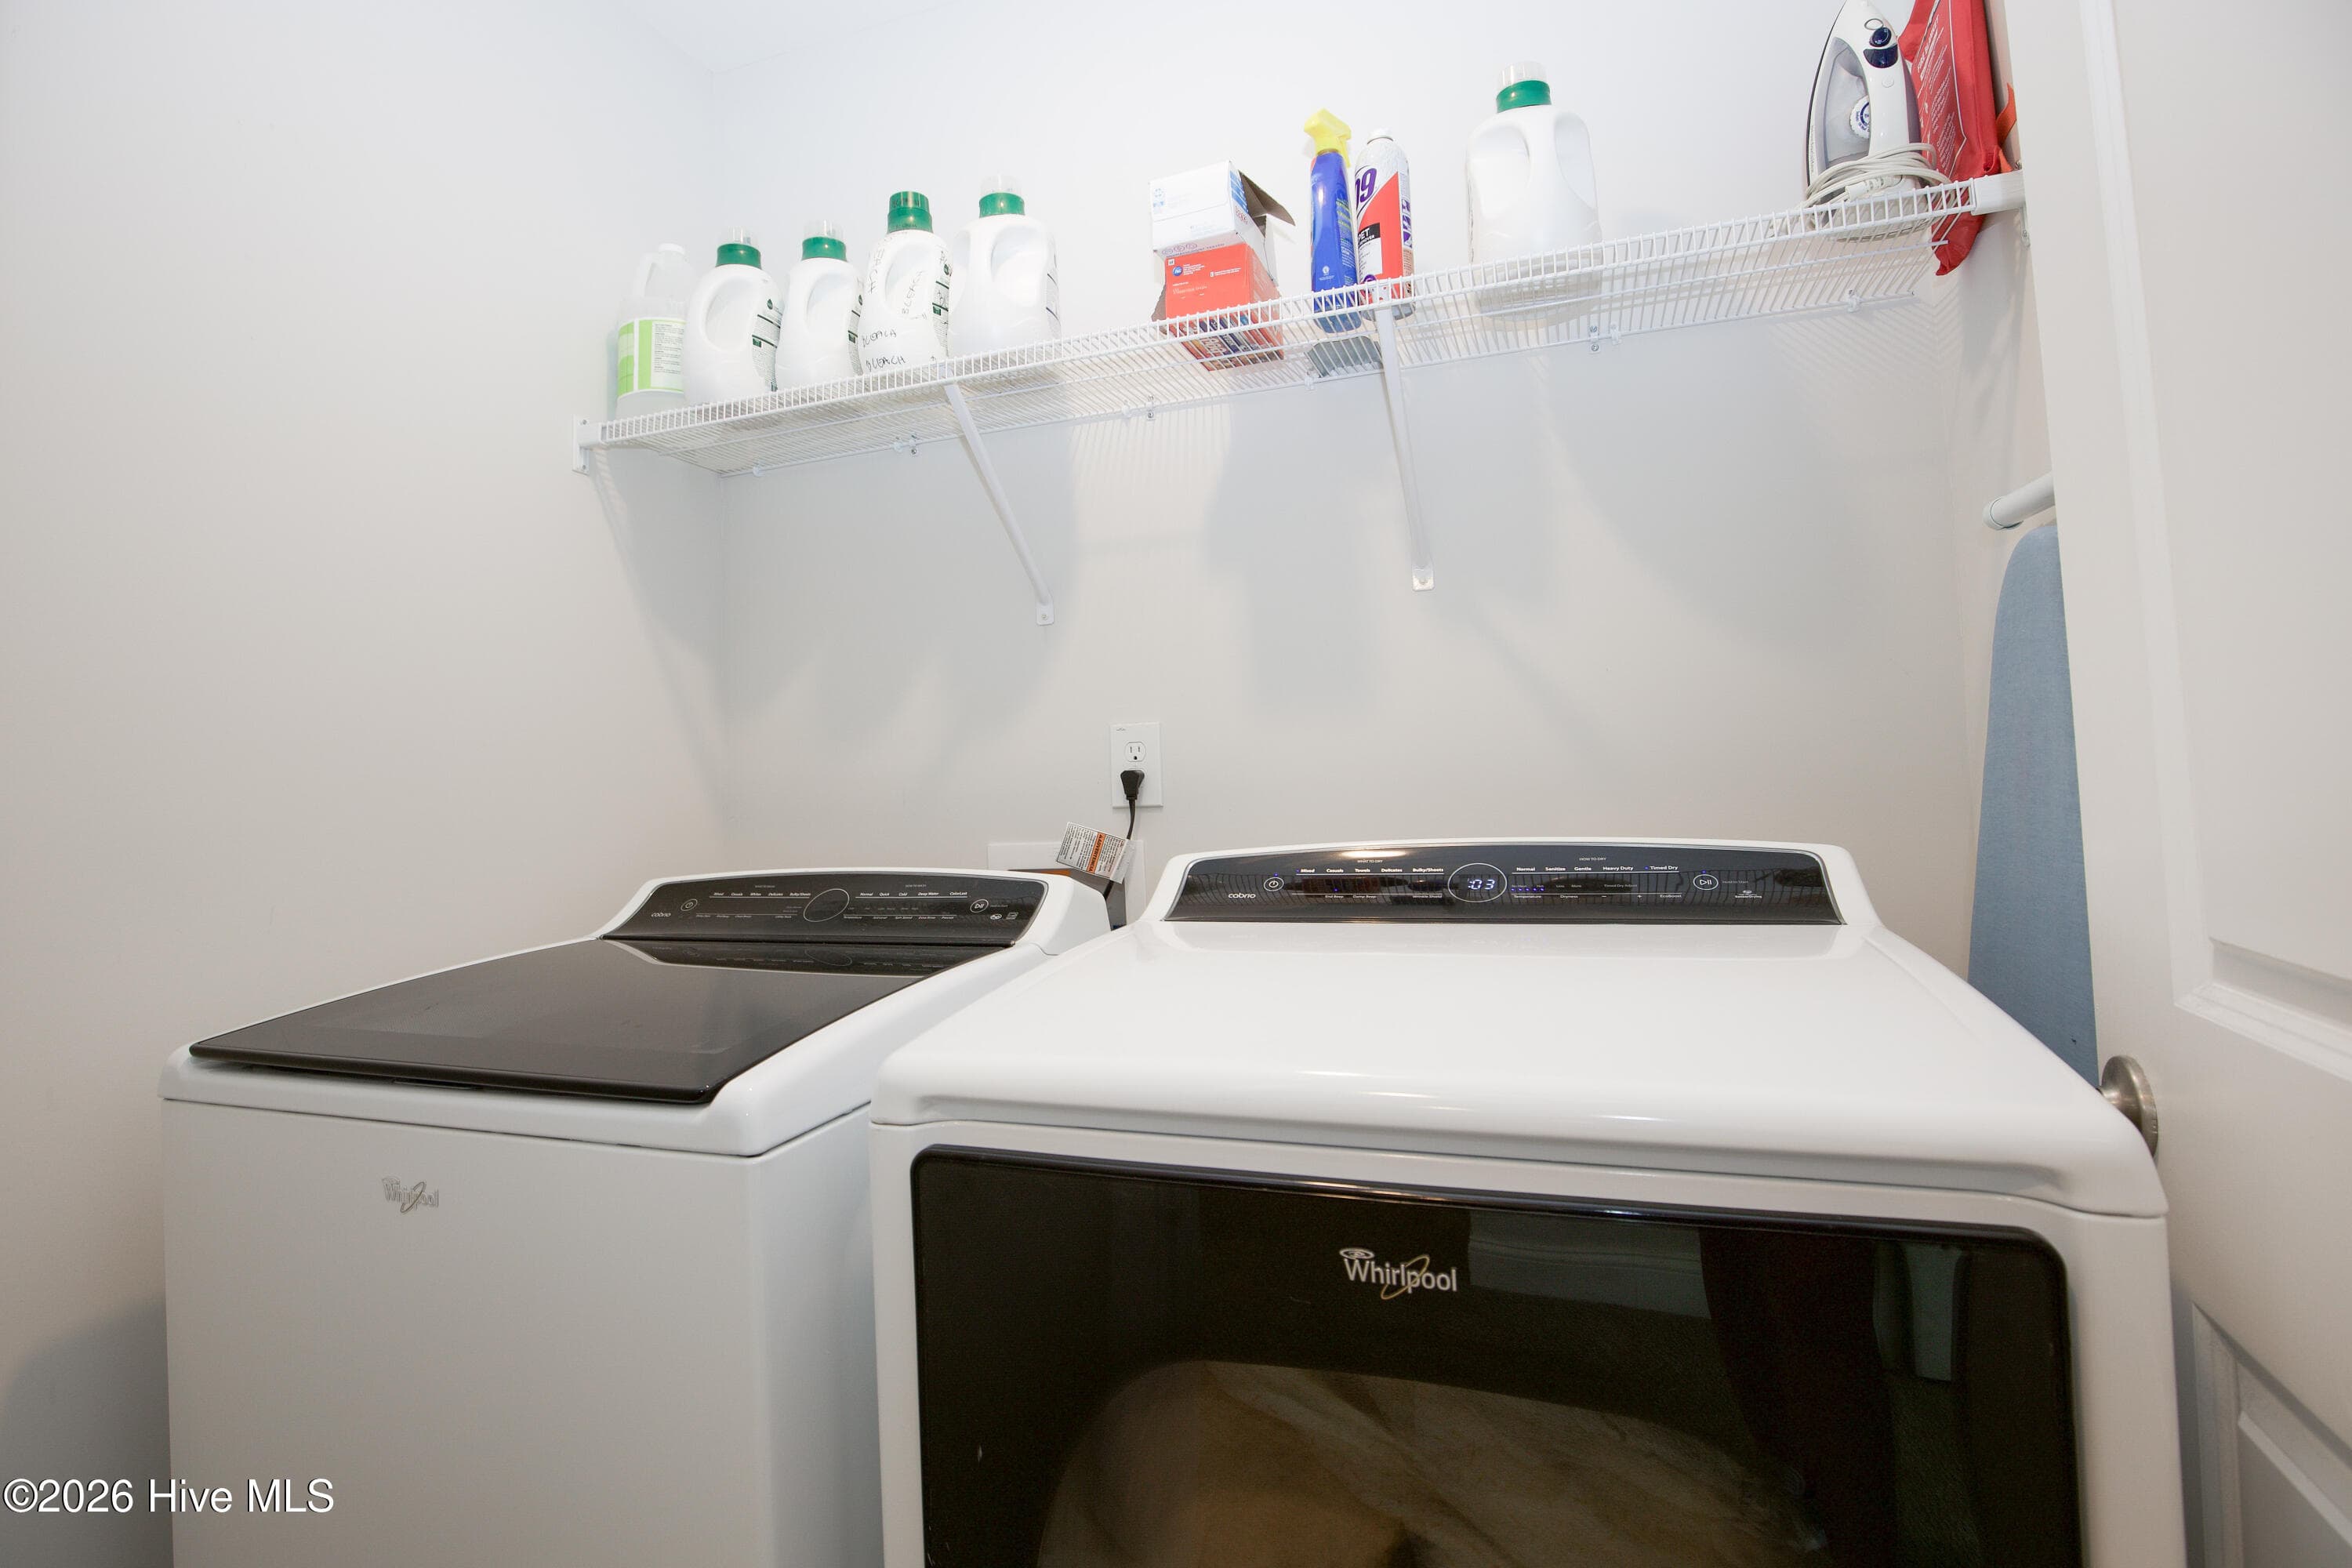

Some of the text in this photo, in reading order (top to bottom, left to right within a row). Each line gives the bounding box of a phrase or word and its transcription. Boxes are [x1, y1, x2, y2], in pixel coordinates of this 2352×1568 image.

[866, 355, 906, 372] BLEACH
[383, 1182, 439, 1211] Whirlpool
[1344, 1258, 1457, 1294] Whirlpool
